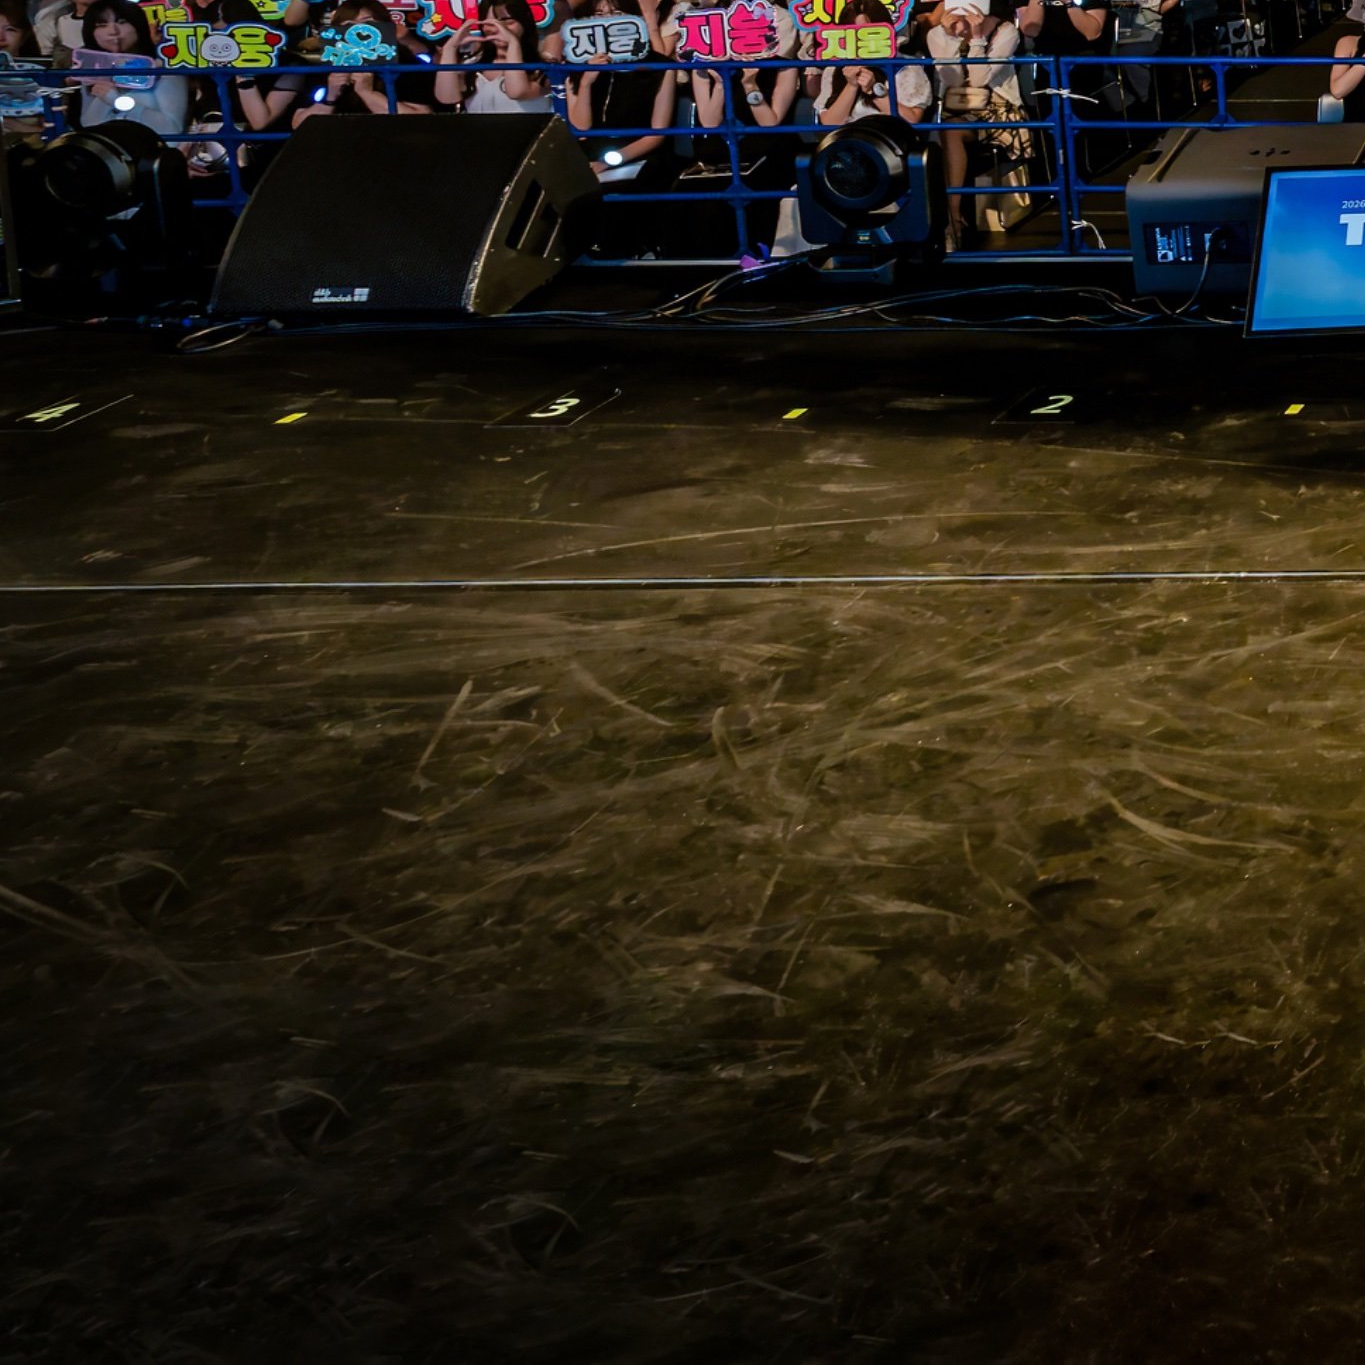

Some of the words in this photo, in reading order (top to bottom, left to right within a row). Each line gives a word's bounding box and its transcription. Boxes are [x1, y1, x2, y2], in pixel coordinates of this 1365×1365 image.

[573, 24, 643, 56] 지웅
[822, 28, 890, 59] 지웅
[1342, 200, 1365, 208] 2026
[26, 402, 81, 422] 4
[528, 398, 580, 418] 3
[1031, 395, 1073, 414] 2
